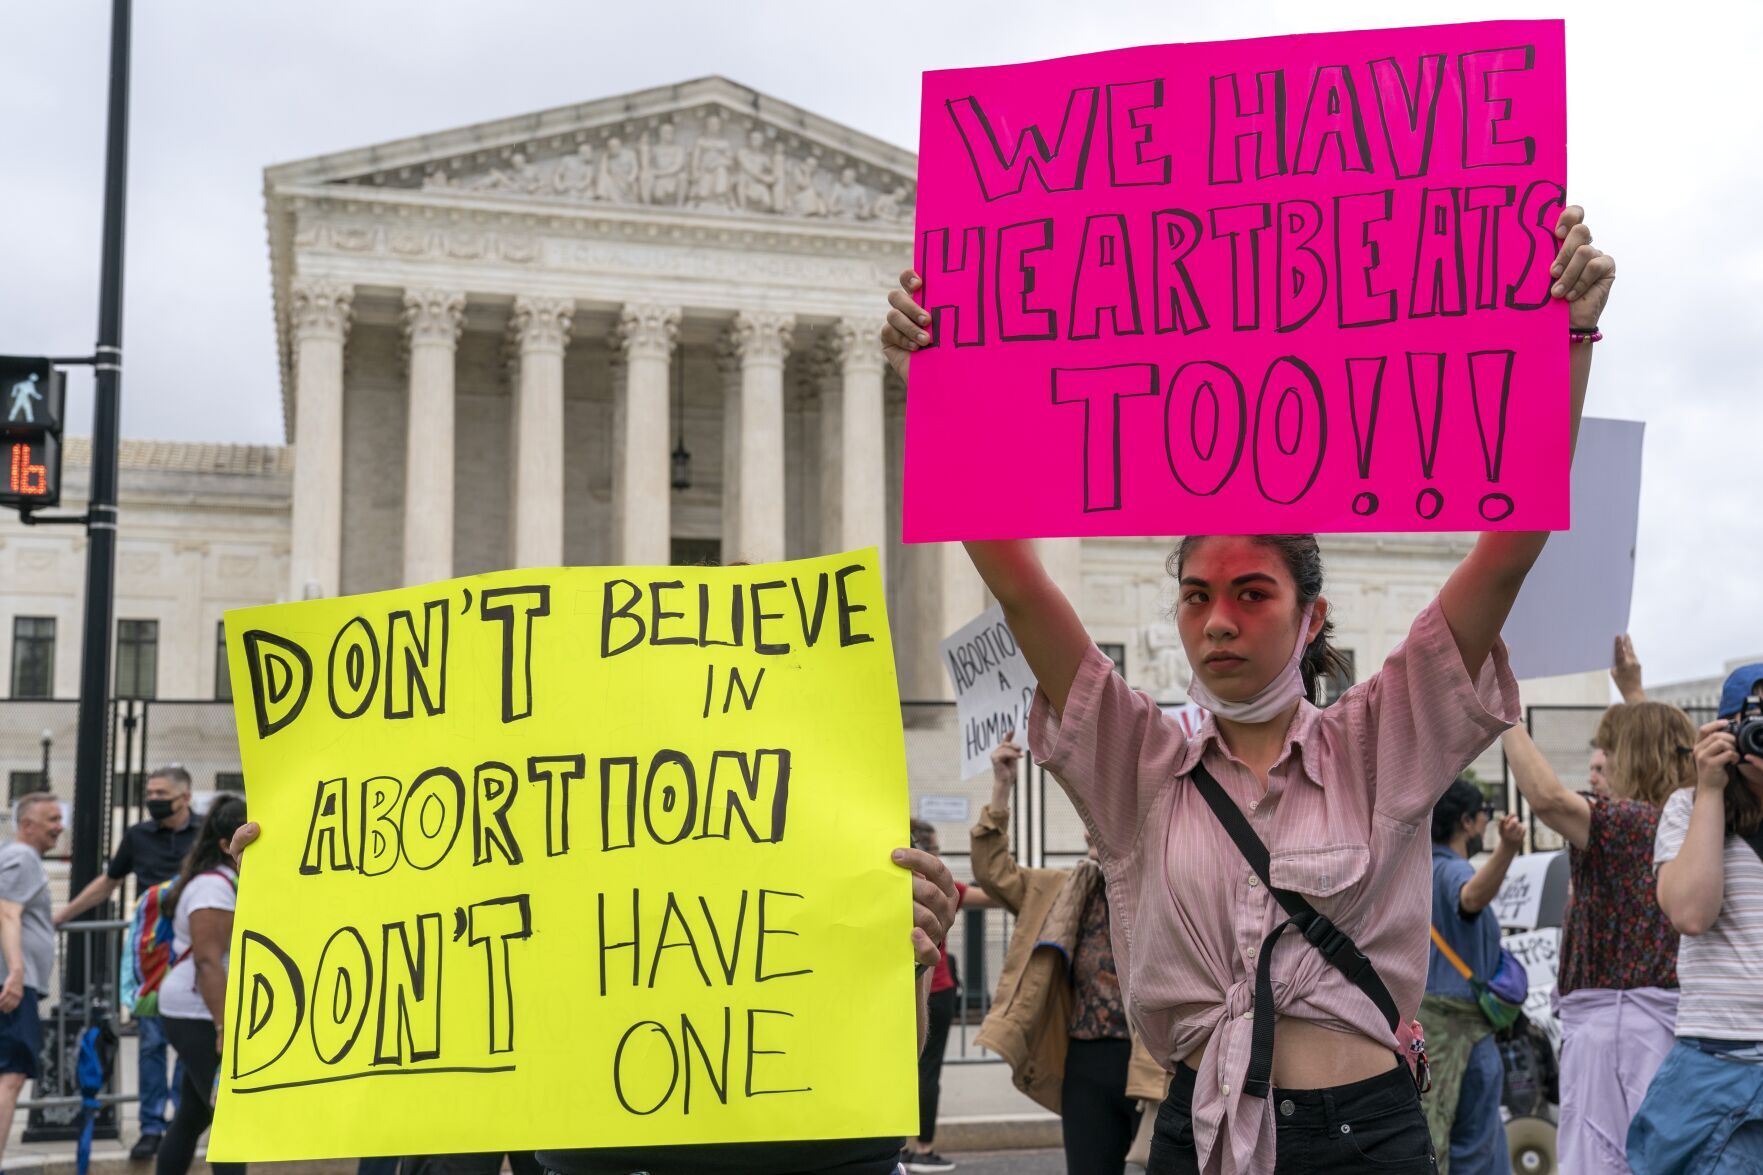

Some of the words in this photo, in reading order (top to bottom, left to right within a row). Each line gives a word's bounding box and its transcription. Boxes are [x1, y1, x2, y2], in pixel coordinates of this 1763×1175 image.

[945, 79, 1172, 203] WE
[1208, 45, 1536, 186] HAVE
[920, 180, 1567, 349] HEARTBEATS
[10, 443, 47, 495] 16
[1050, 350, 1517, 522] TOO!!!
[242, 584, 551, 740] DON'T
[600, 564, 876, 659] BELIEVE
[703, 664, 766, 719] IN
[948, 622, 1017, 696] ABORTIO
[997, 670, 1012, 692] A
[965, 704, 1019, 761] HUMAN
[298, 748, 792, 877] ABORTION
[231, 893, 534, 1081] DON'T
[597, 887, 815, 998] HAVE
[613, 1006, 814, 1116] ONE
